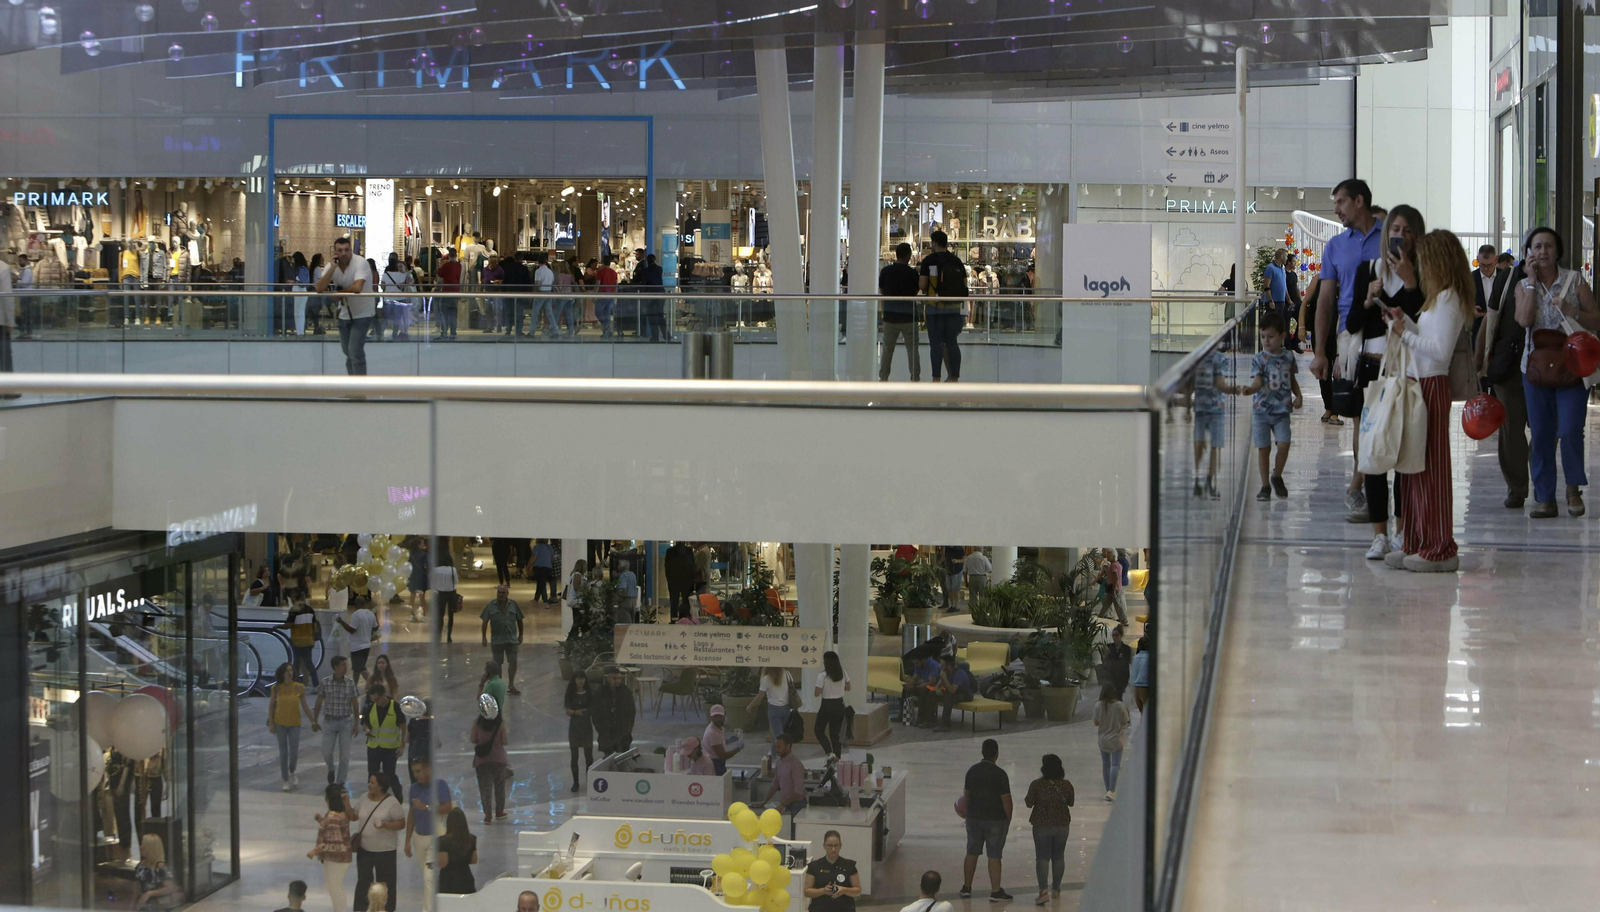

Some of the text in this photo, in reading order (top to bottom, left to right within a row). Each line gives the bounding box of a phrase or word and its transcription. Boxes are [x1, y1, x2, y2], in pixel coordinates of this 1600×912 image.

[13, 191, 109, 206] PRIMARK
[1083, 274, 1131, 298] lagoh
[709, 631, 731, 639] yelmo
[693, 640, 708, 648] Lago
[693, 646, 735, 654] Restaurantes
[643, 653, 671, 661] lactancia
[693, 654, 722, 662] Ascensor
[637, 828, 712, 846] d-uñas
